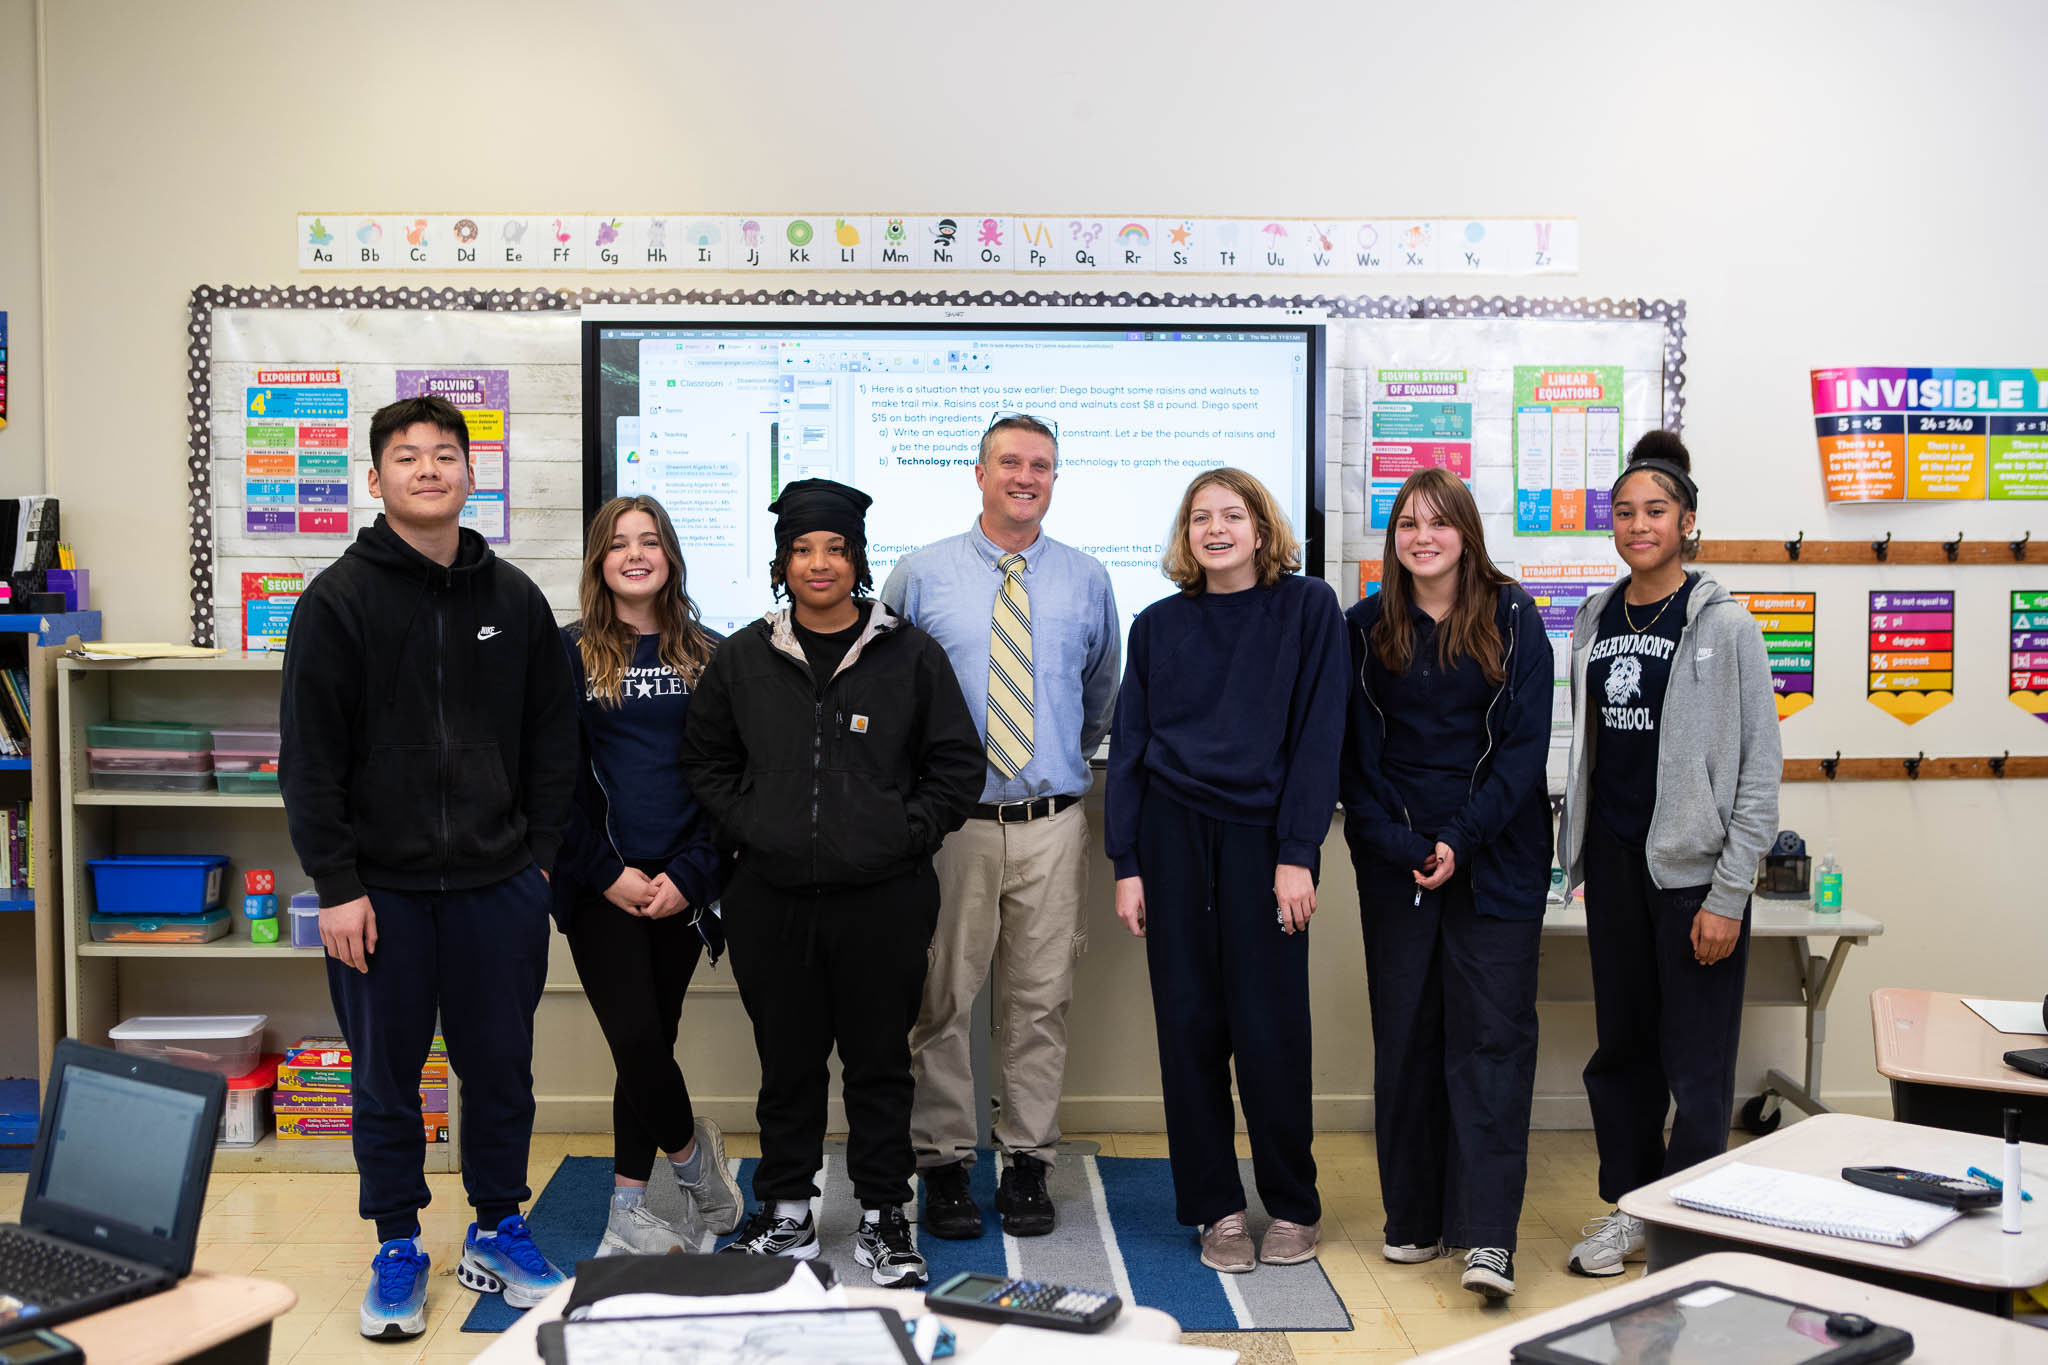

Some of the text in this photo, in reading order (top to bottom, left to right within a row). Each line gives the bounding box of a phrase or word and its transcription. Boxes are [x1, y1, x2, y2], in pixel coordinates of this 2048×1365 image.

[314, 249, 332, 261] Aa
[362, 248, 379, 261] Bb
[411, 248, 425, 261] Cc
[458, 248, 475, 261] Dd
[506, 248, 522, 261] Ee
[554, 248, 570, 261] Ff
[601, 249, 618, 264] Gg
[648, 249, 667, 262] Hh
[699, 248, 710, 261] Ii
[747, 249, 758, 266] Jj
[790, 249, 809, 262] Kk
[842, 249, 854, 262] Ll
[883, 249, 908, 262] Mm
[934, 249, 952, 262] Nn
[981, 249, 1000, 262] Oo
[1031, 250, 1046, 267] Pp
[1076, 250, 1096, 267] Qq
[1126, 251, 1141, 263] Rr
[1174, 252, 1187, 264] Ss
[1220, 252, 1235, 265] Tt
[1268, 252, 1284, 266] Uu
[1313, 253, 1329, 266] Vv
[1357, 253, 1379, 266] Ww
[1407, 253, 1423, 265] Xx
[1465, 253, 1480, 267] Yy
[261, 372, 337, 382] EXPONENT RULES
[1382, 372, 1464, 380] SOLVING SYSTEMS
[1548, 374, 1588, 386] LINEAR
[430, 380, 474, 391] SOLVING
[859, 384, 866, 394] 1)
[916, 385, 957, 393] situation
[1060, 385, 1087, 396] Diego
[1090, 386, 1124, 396] bought
[1156, 386, 1186, 394] raisins
[1188, 386, 1207, 395] and
[1210, 387, 1247, 395] walnuts
[1390, 384, 1454, 395] OF EQUATIONS
[424, 392, 482, 404] ATIONS
[1539, 387, 1599, 400] EQUATIONS
[1835, 379, 2024, 409] INVISIBLE
[251, 393, 266, 414] 4
[1002, 399, 1014, 408] $4
[1025, 400, 1056, 409] pound
[1059, 400, 1077, 408] and
[1080, 400, 1117, 408] walnuts
[1143, 400, 1154, 409] $8
[1202, 401, 1229, 411] Diego
[1232, 402, 1258, 410] spent
[872, 413, 886, 422] $15
[905, 414, 926, 422] both
[930, 415, 984, 424] ingredients.
[1920, 417, 1937, 431] 24
[1838, 418, 1849, 431] 5
[879, 428, 888, 438] a)
[895, 428, 919, 436] Write
[937, 429, 978, 438] equation
[1116, 429, 1129, 437] Let
[1174, 430, 1209, 438] pounds
[1212, 430, 1221, 438] of
[1257, 430, 1275, 438] and
[933, 443, 968, 453] pounds
[1836, 440, 1865, 449] There
[1867, 440, 1876, 448] is
[1928, 442, 1949, 450] There
[1951, 442, 1958, 450] is
[2012, 440, 2039, 449] There
[1829, 450, 1892, 462] positive sign
[1919, 452, 1974, 462] decimal point
[880, 457, 979, 469] b) Technology requi
[1065, 458, 1118, 468] technology
[1133, 458, 1161, 468] graph
[1164, 458, 1179, 466] the
[1831, 460, 1892, 471] to the left of
[1930, 463, 1944, 471] the
[1945, 463, 1960, 471] end
[1962, 462, 1972, 471] of
[2014, 462, 2026, 470] to
[2027, 462, 2043, 470] the
[1828, 472, 1854, 482] every
[1922, 473, 1969, 483] every whole
[1999, 473, 2026, 482] every
[872, 544, 920, 554] Complete
[1082, 544, 1129, 556] ingredient
[1133, 545, 1152, 554] that
[1523, 566, 1615, 576] STRAIGHT LINE GRAPHS
[268, 580, 304, 592] SEQUE
[1754, 598, 1807, 609] segment xy
[1893, 598, 1900, 606] is
[1902, 598, 1915, 606] not
[1916, 598, 1938, 607] equal
[1892, 616, 1903, 628] pi
[1892, 636, 1926, 648] degree
[1589, 634, 1675, 663] SHAWMONT
[1769, 657, 1810, 666] arallel to
[1893, 656, 1929, 667] percent
[1893, 675, 1919, 687] angle
[1602, 707, 1654, 730] SCHOOL
[292, 1095, 336, 1103] Operations
[440, 1130, 448, 1141] 4
